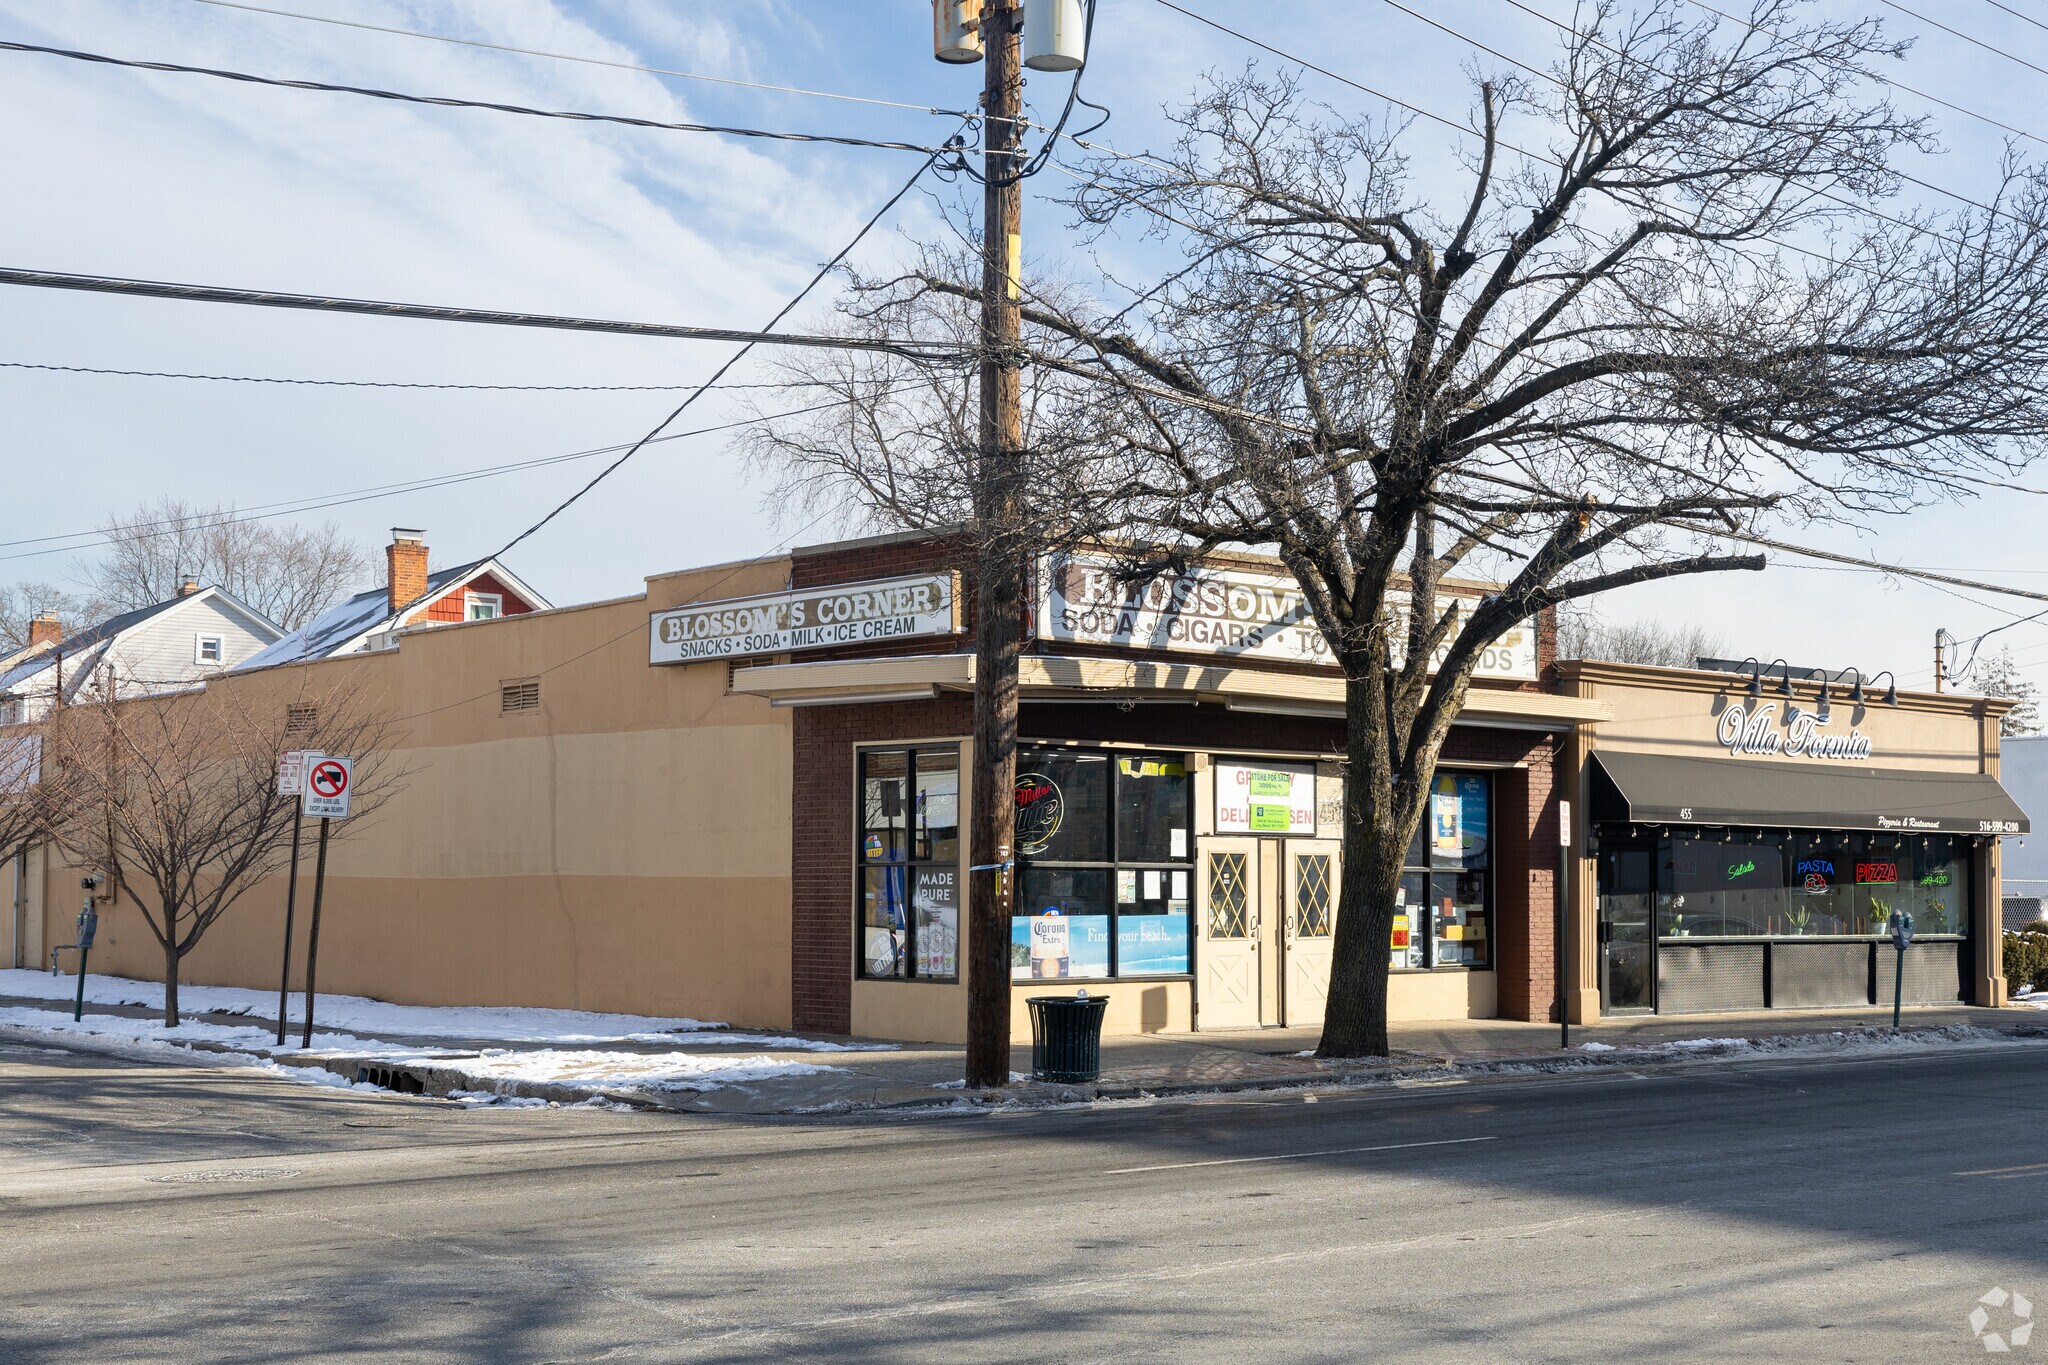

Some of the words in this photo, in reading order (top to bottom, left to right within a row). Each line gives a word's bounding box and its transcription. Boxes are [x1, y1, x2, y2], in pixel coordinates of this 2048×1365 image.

[667, 601, 805, 642] BLOSSOM'S
[817, 585, 932, 624] CORNER
[1061, 608, 1135, 637] SODA
[1166, 617, 1264, 649] CIGARS
[680, 637, 732, 658] SNACKS
[744, 632, 780, 652] SODA
[791, 626, 825, 647] MILK
[833, 623, 857, 642] ICE
[863, 616, 915, 638] CREAM
[1718, 702, 1780, 755] Villa
[1783, 707, 1872, 759] Formia
[1251, 772, 1267, 781] STORE
[1278, 774, 1290, 782] SALE
[1015, 784, 1052, 806] Miller
[1015, 799, 1058, 832] ite
[1220, 807, 1312, 824] DELISEN
[1680, 808, 1692, 820] 455
[1878, 815, 1901, 828] Pizzeria
[1902, 817, 1907, 827] &
[1908, 817, 1940, 829] Restaurant
[1979, 820, 2019, 832] 516-599-4200
[1728, 861, 1755, 880] Salads
[1797, 859, 1835, 875] PASTA
[1855, 863, 1898, 882] PIZZA
[920, 873, 953, 885] MADE
[1034, 921, 1066, 937] Corona
[1042, 935, 1061, 944] Extra
[1117, 932, 1139, 945] your
